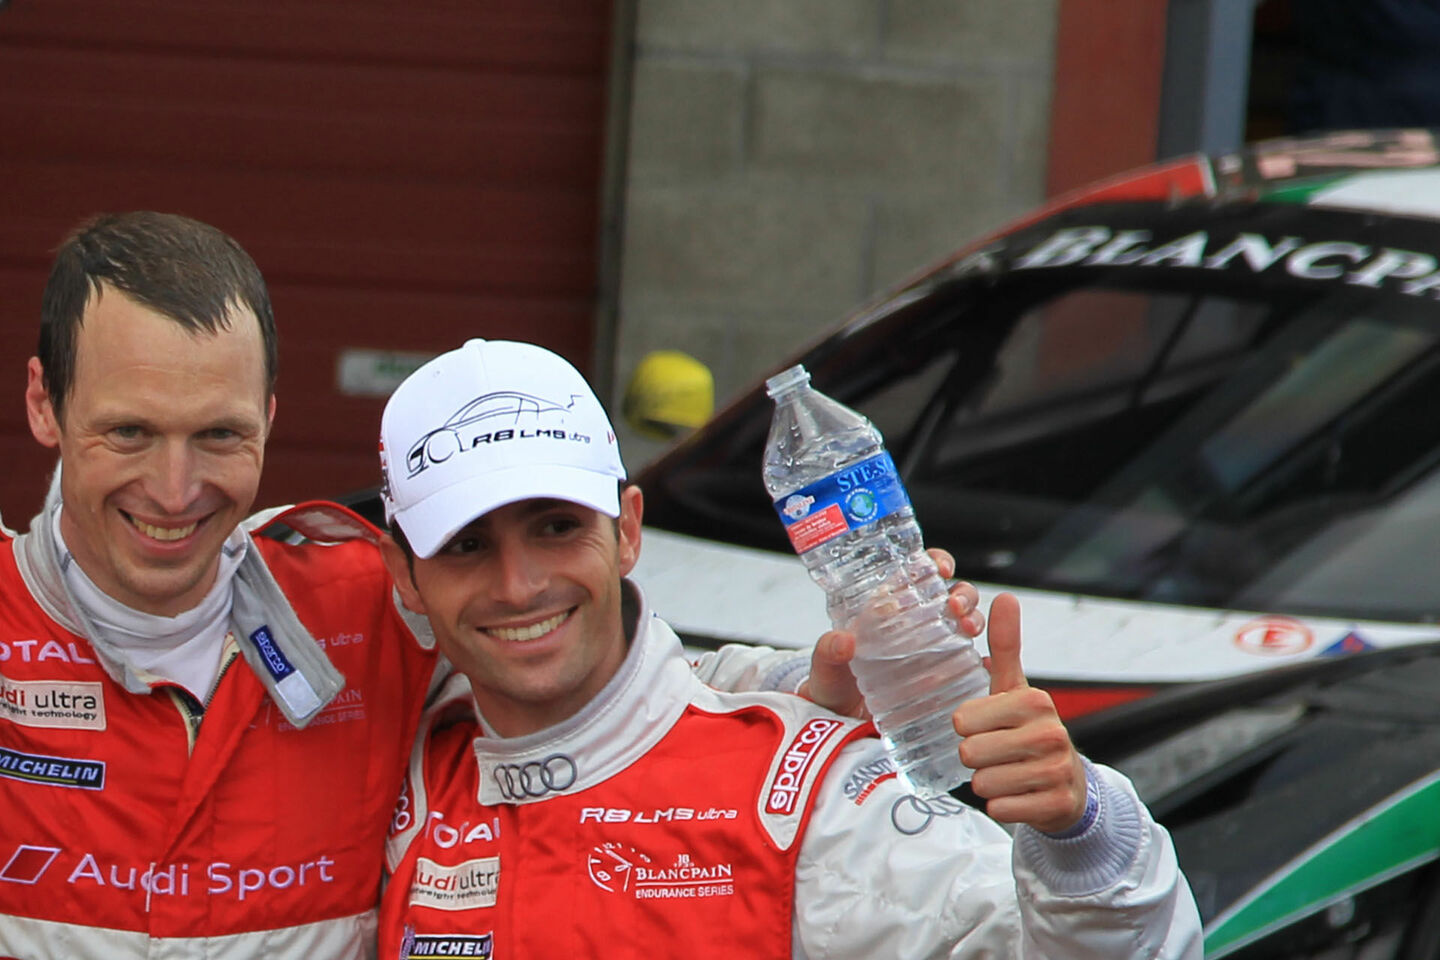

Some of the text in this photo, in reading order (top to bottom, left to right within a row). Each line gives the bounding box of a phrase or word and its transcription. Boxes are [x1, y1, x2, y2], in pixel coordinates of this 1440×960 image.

[472, 429, 515, 449] R8
[520, 429, 566, 439] LMS
[256, 631, 287, 675] sparco
[34, 690, 97, 710] ultra
[32, 710, 97, 721] technology
[769, 720, 838, 812] sparco
[844, 757, 893, 800] SANDT
[580, 807, 738, 824] R8 LMS ultra
[68, 854, 335, 900] Audi Sport
[416, 872, 457, 891] udi
[635, 864, 732, 881] BLANCPAIN
[635, 885, 734, 899] ENDURANCE SERIES
